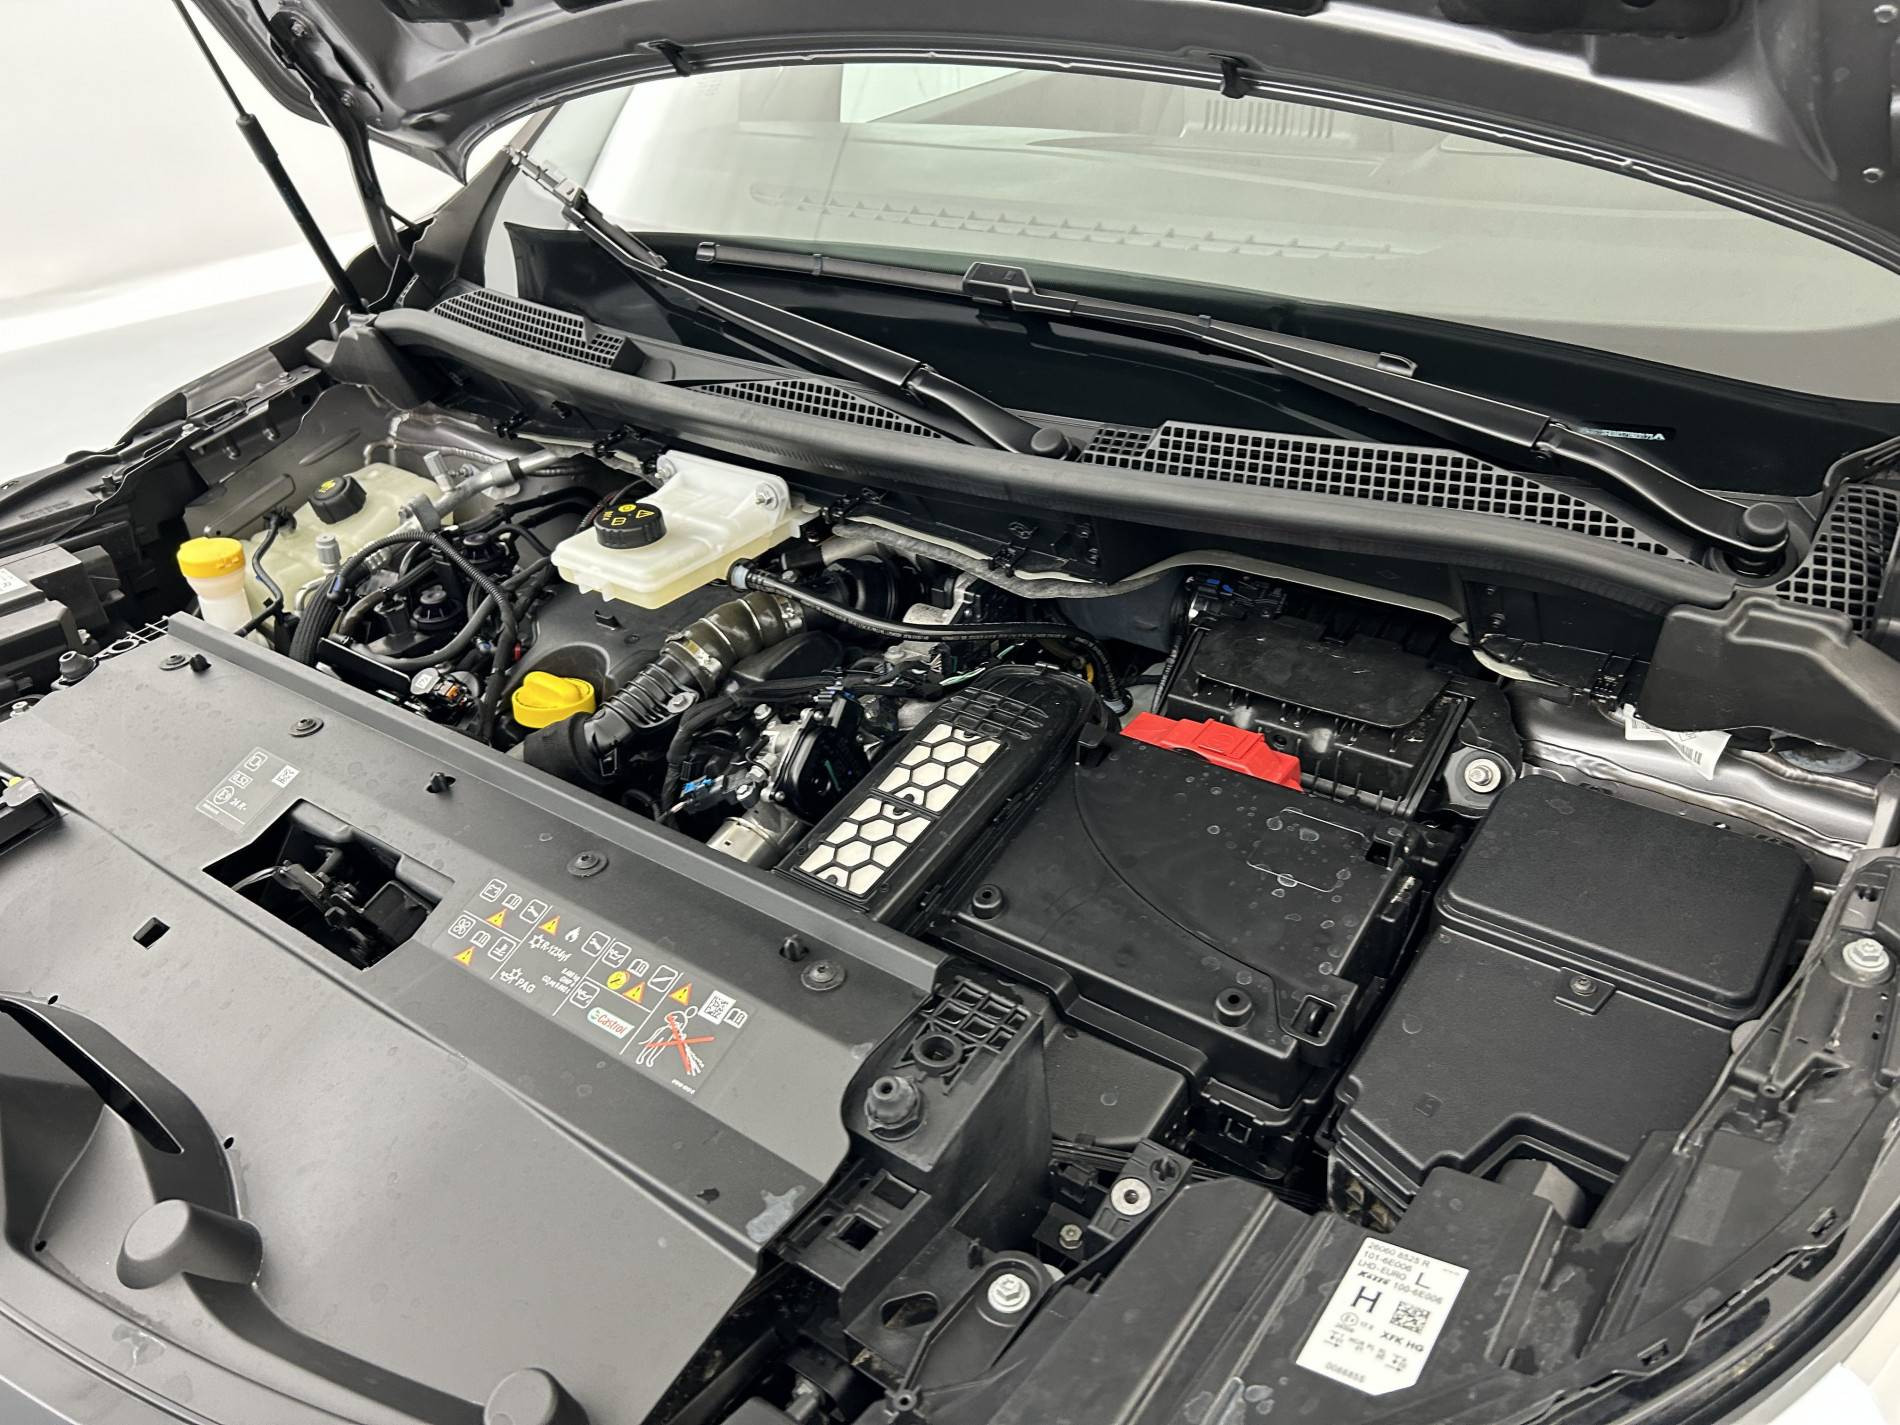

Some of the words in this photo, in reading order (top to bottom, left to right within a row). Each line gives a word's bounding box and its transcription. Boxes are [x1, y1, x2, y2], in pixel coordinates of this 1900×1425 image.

[516, 977, 535, 994] PAG
[597, 1014, 626, 1034] Castrol
[1421, 1259, 1431, 1268] R
[1415, 1271, 1431, 1290] L
[1350, 1285, 1382, 1313] H
